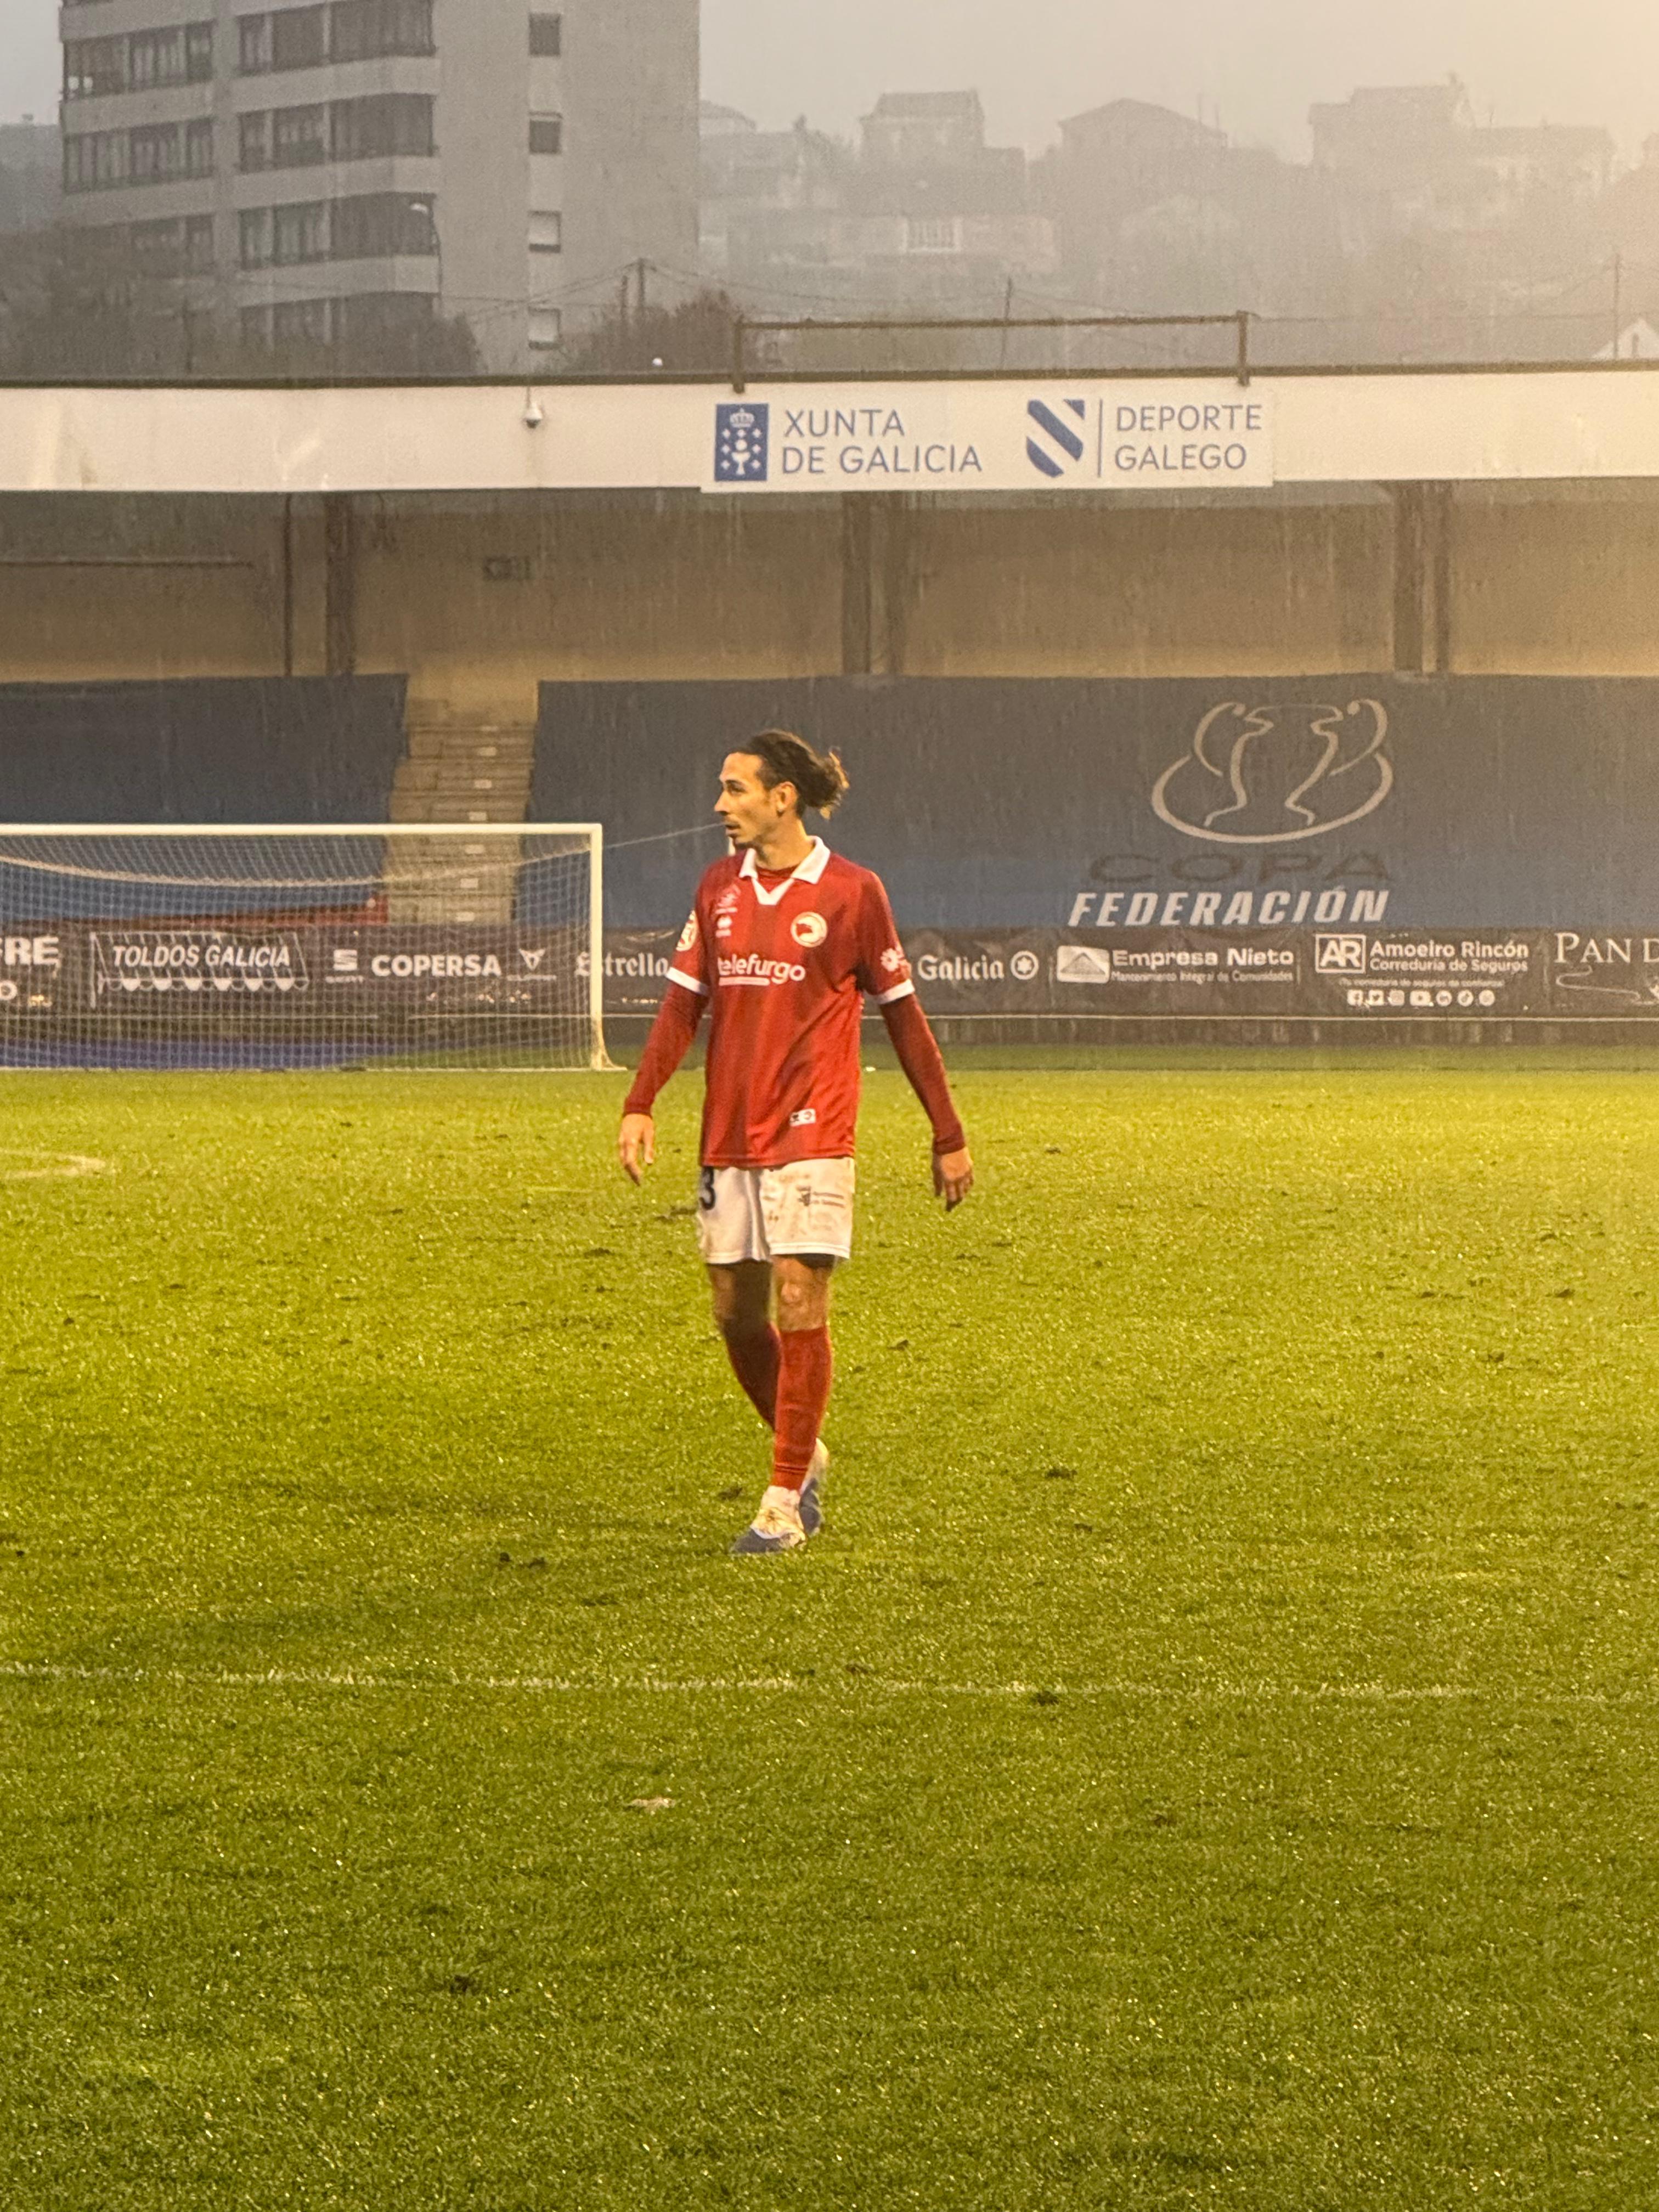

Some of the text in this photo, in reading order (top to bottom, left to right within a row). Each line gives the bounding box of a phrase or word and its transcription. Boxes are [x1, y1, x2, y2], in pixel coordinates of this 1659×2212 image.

[785, 409, 905, 437] XUNTA
[1116, 404, 1263, 432] DEPORTE
[782, 444, 982, 475] DE GALICIA
[1115, 443, 1247, 471] GALEGO
[1090, 853, 1390, 883] COPA
[1068, 886, 1389, 927] FEDERACIÓN
[112, 945, 290, 967] TOLDOS GALICIA
[1112, 947, 1294, 970] Empresa Nieto
[1319, 940, 1362, 967] AR
[1369, 939, 1530, 958] Amoeiro Rincón
[1554, 932, 1632, 963] PAN
[371, 955, 502, 977] COPERSA
[717, 953, 806, 984] telefurgo
[917, 954, 1005, 981] Galicia
[1448, 958, 1468, 972] de
[1471, 959, 1528, 974] Seguros
